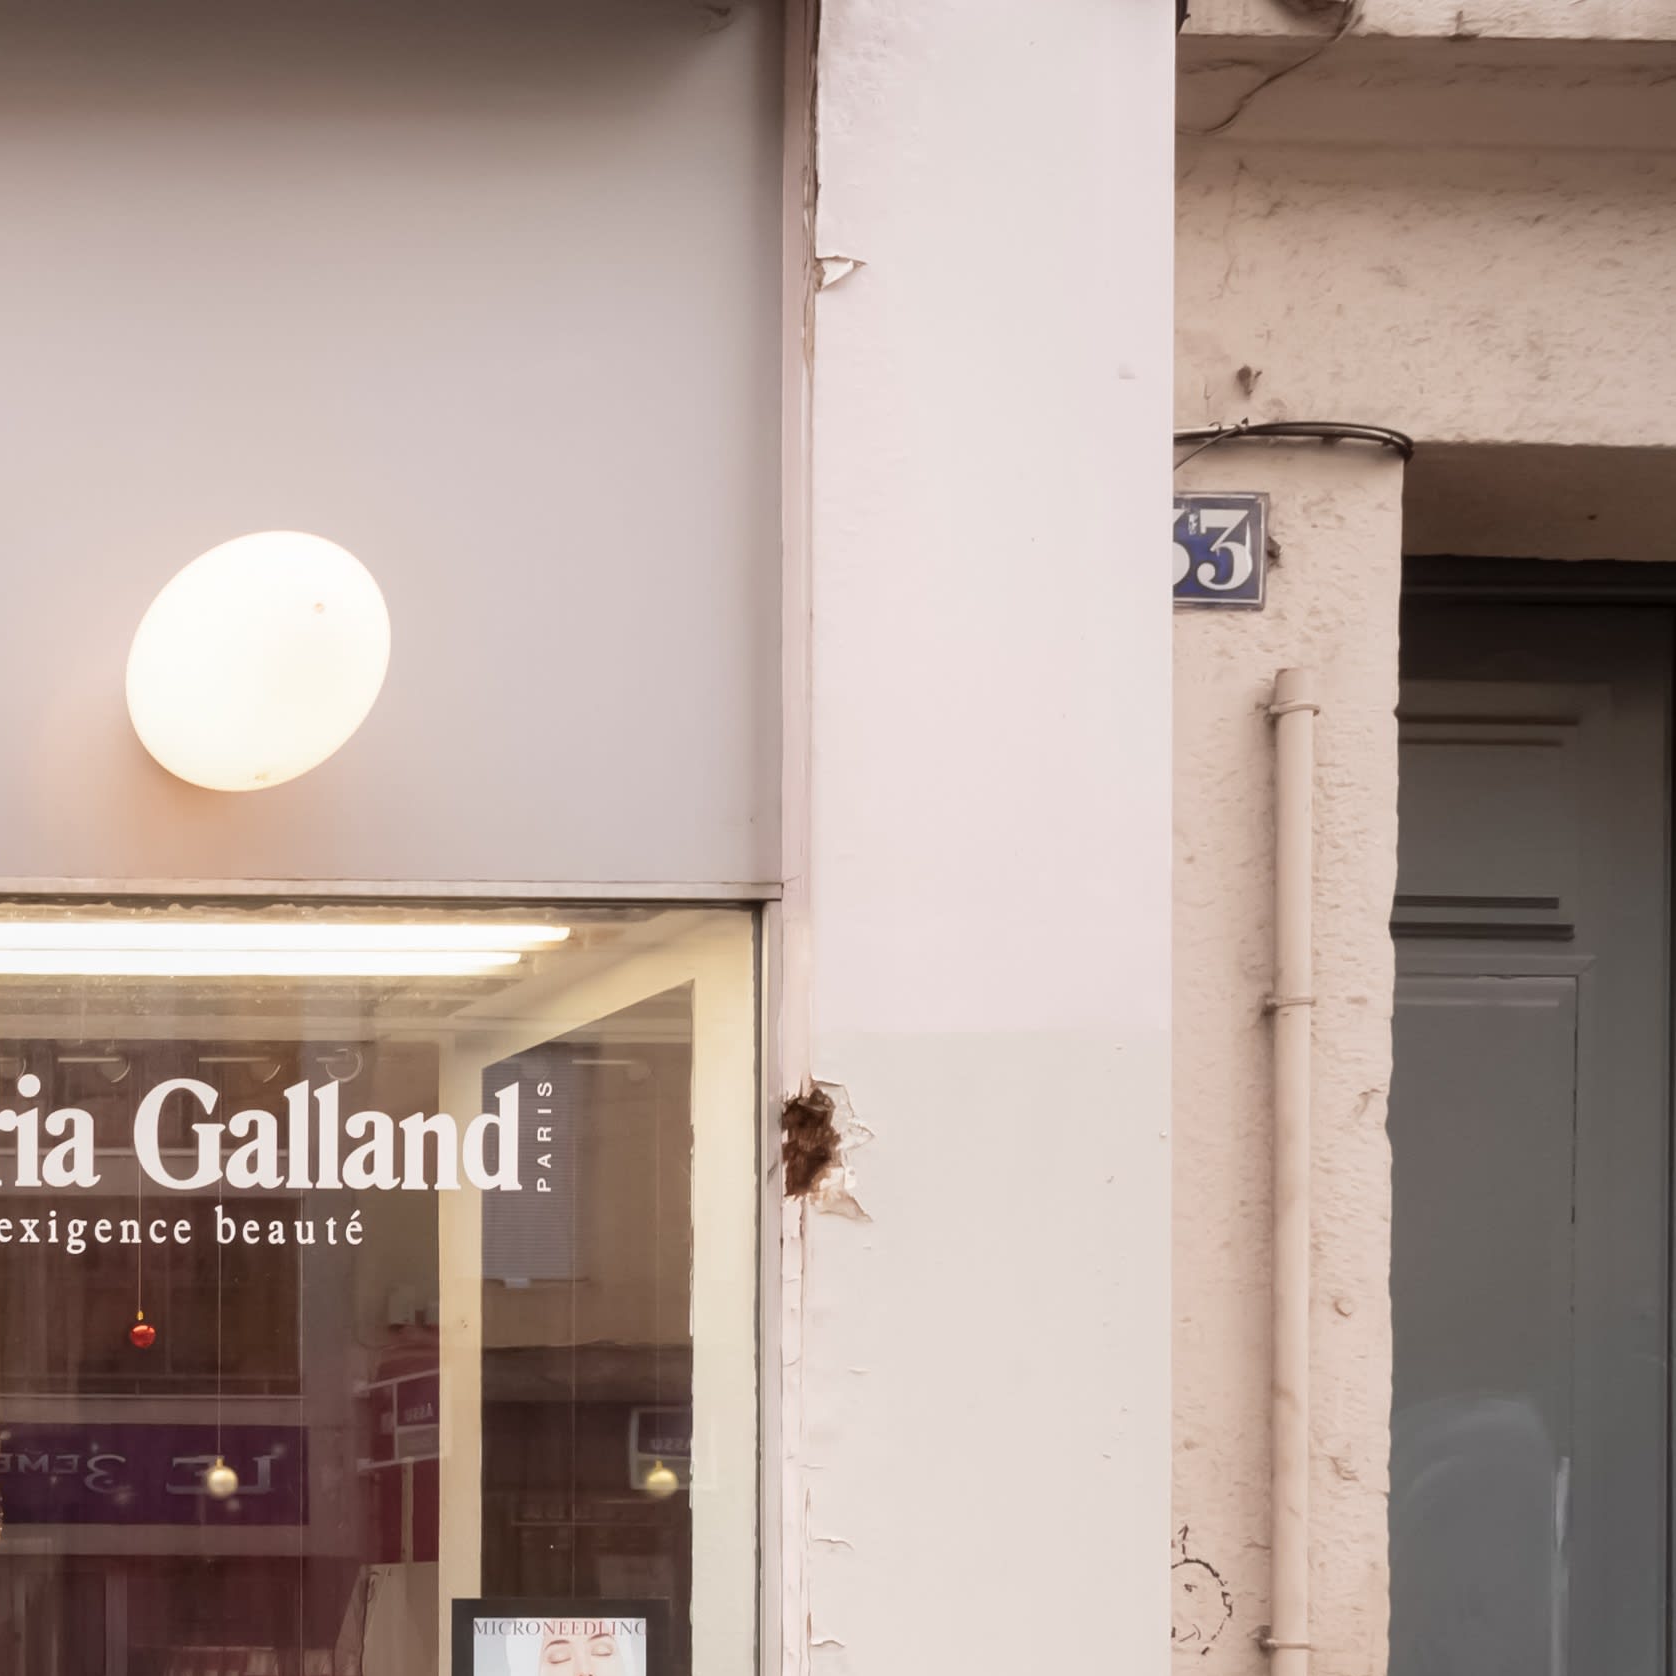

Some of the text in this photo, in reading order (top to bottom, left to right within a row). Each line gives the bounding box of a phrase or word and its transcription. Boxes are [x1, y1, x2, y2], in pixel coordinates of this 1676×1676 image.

[134, 1077, 523, 1192] Galland
[536, 1081, 553, 1193] PARIS
[215, 1205, 365, 1247] beauté
